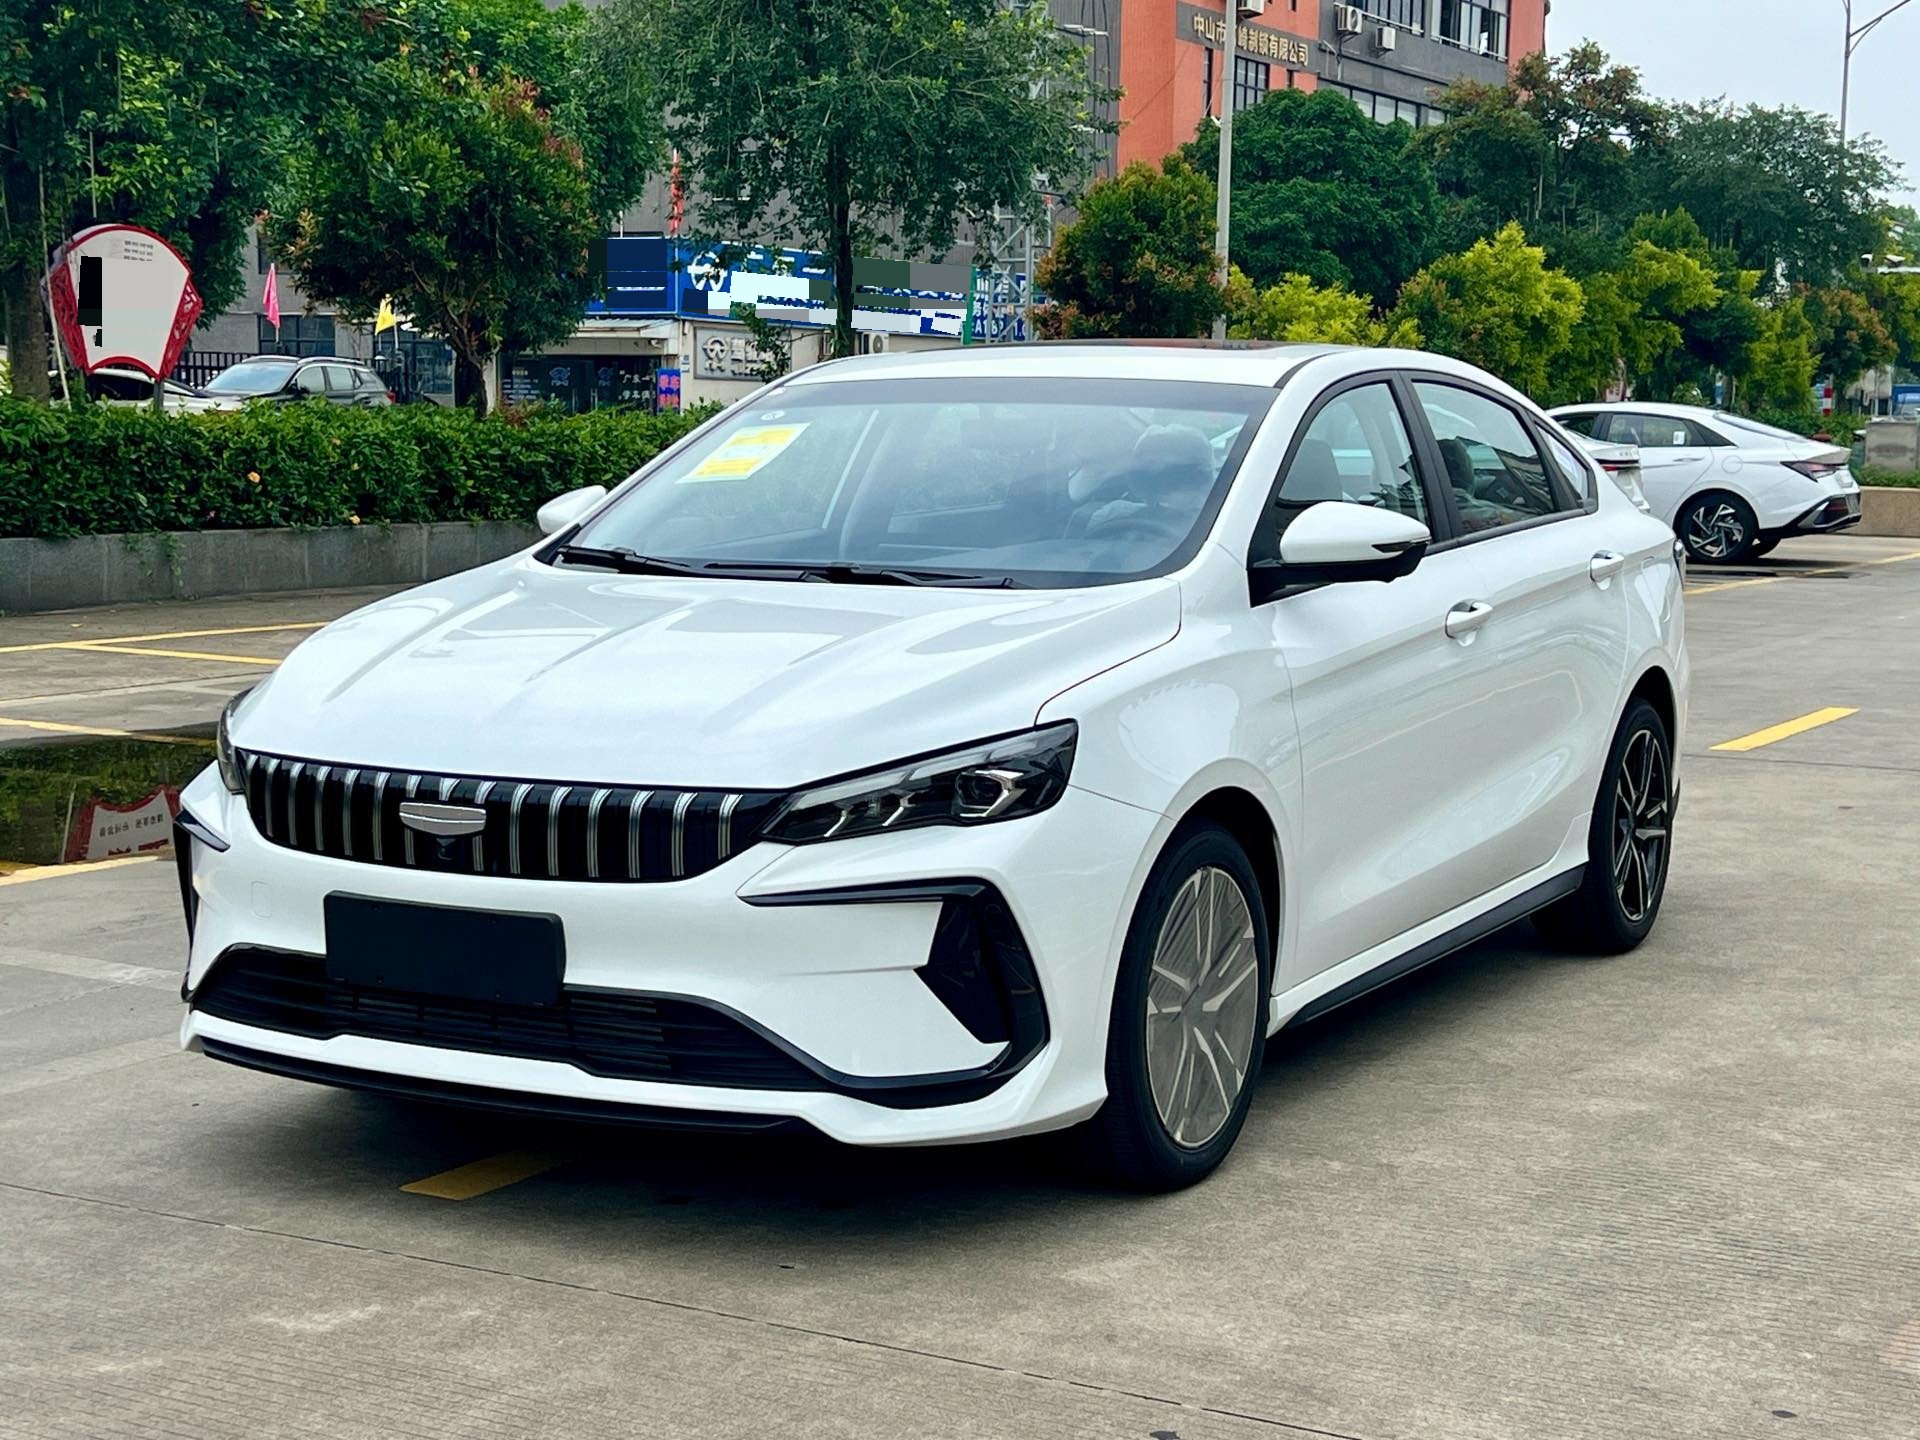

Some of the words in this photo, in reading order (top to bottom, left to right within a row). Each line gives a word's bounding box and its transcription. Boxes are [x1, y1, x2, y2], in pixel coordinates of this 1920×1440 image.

[1193, 13, 1309, 66] 中山市崎制锁有限公司
